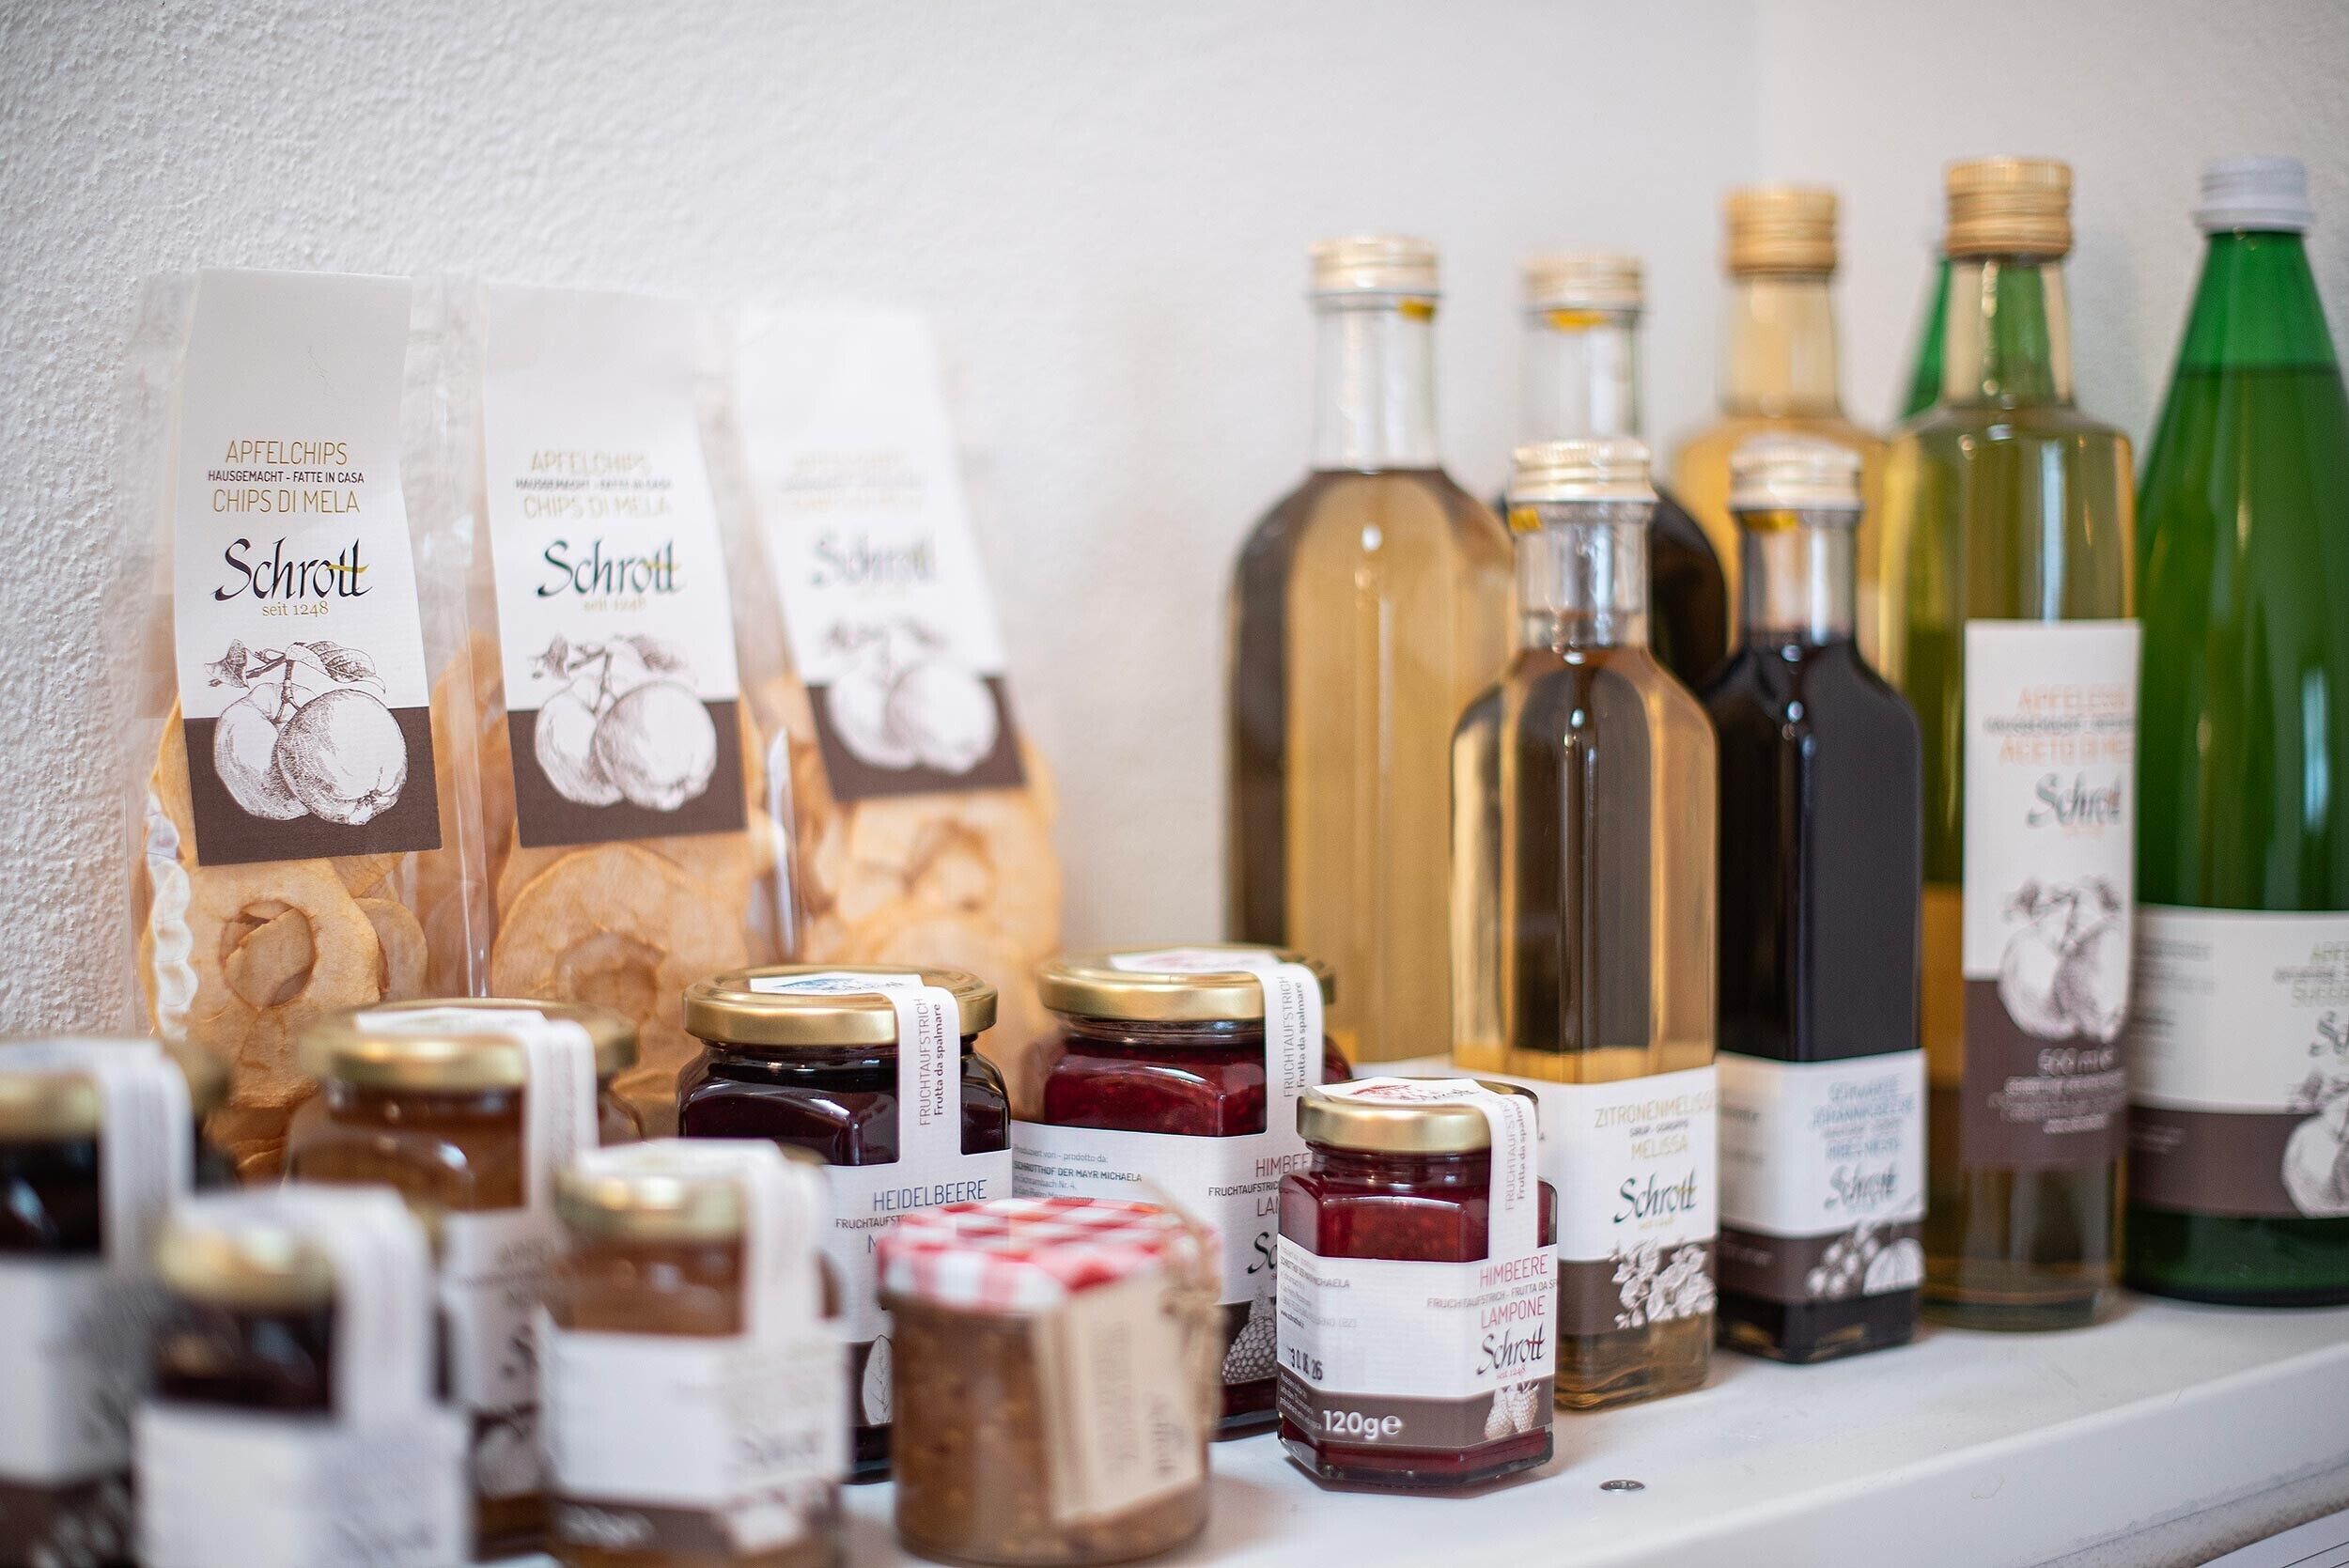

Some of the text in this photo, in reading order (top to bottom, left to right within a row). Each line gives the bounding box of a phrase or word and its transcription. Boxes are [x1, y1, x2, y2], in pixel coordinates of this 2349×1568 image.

[226, 440, 348, 465] APFELCHIPS
[208, 470, 283, 483] HAUSGEMACHT
[293, 471, 322, 483] FATTE
[325, 472, 334, 484] IN
[337, 472, 365, 484] CASA
[213, 489, 360, 513] CHIPS DI MELA
[210, 536, 373, 601] Schrott
[536, 537, 688, 598] Schrott
[262, 601, 329, 617] seit 1248
[1277, 976, 1295, 1097] FRUCHTAUFSTRICH
[1296, 982, 1308, 1088] Frutta da spalmare
[914, 999, 931, 1126] FRUCHTAUFSTRICH
[933, 1004, 945, 1115] Frutta da spalmare
[1517, 1145, 1525, 1159] da
[1058, 1168, 1073, 1177] DER
[1076, 1170, 1098, 1179] MAYR
[1100, 1172, 1143, 1182] MICHAELA
[1208, 1181, 1279, 1196] FRUCHTAUFSTRIC
[1517, 1163, 1525, 1200] Frutta
[874, 1179, 988, 1211] HEIDELBEERE
[1612, 1168, 1698, 1223] Schrott
[1480, 1254, 1548, 1289] HIMBEERE
[1511, 1283, 1537, 1297] FRUTTA
[1482, 1296, 1547, 1328] LAMPONE
[1476, 1322, 1548, 1375] Schrott
